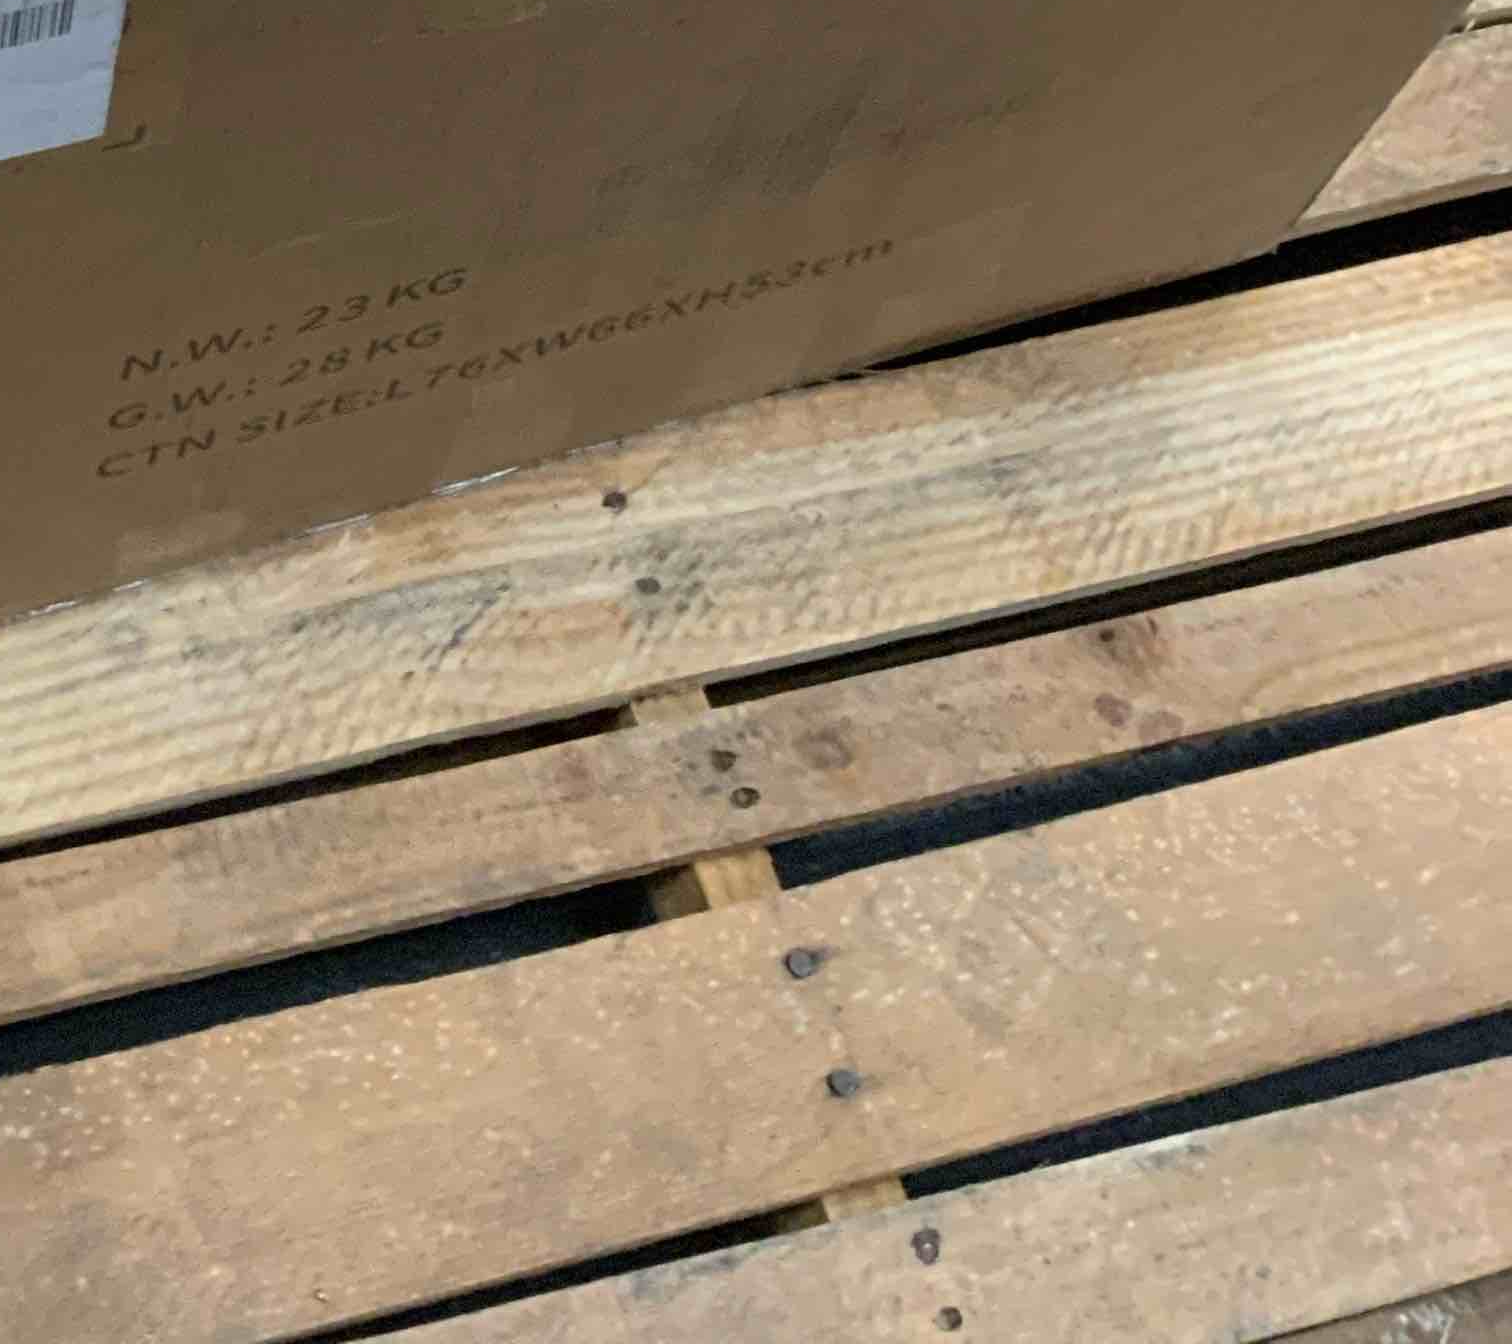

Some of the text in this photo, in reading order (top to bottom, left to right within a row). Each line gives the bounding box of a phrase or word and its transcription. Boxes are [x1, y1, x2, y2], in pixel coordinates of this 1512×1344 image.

[107, 320, 446, 431] G.W.: 28 KG
[121, 266, 468, 381] N.W.: 23 KG
[95, 428, 216, 480] CTN
